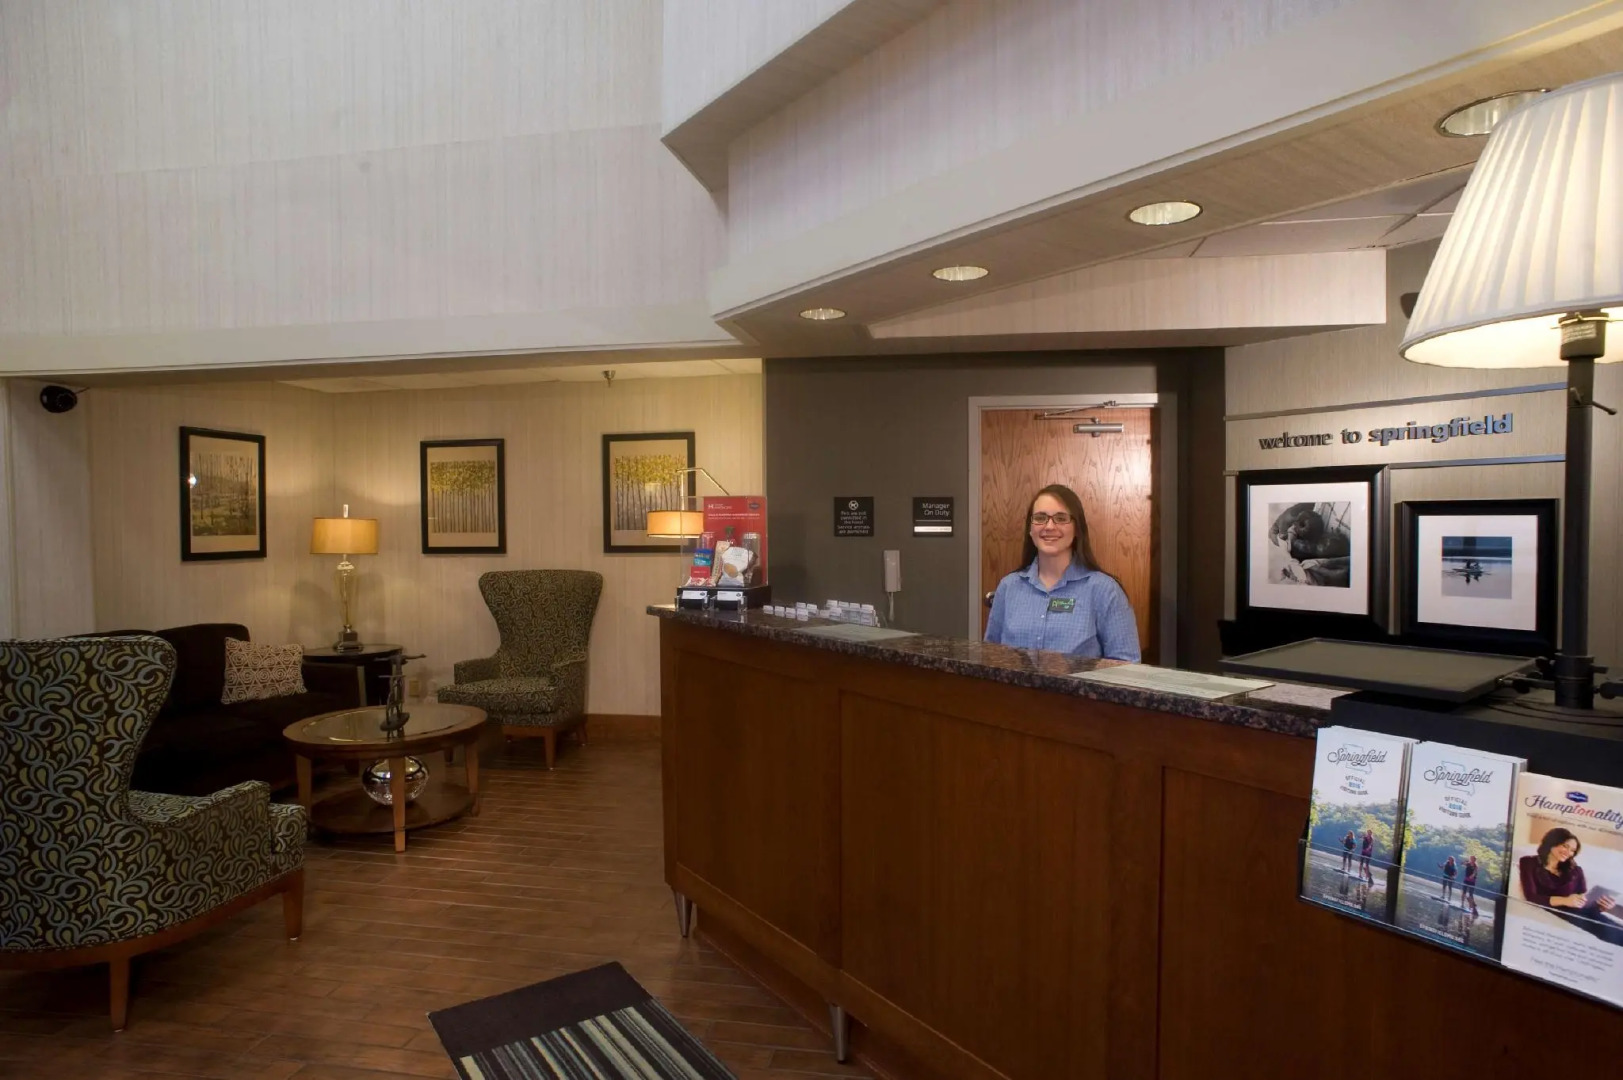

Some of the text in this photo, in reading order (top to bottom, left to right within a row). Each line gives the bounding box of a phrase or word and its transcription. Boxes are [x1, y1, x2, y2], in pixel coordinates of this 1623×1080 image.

[1259, 412, 1514, 450] welcome to springfield
[1327, 748, 1388, 766] Springfield
[1423, 766, 1496, 786] Springfield
[1525, 795, 1623, 829] Hamptonality
